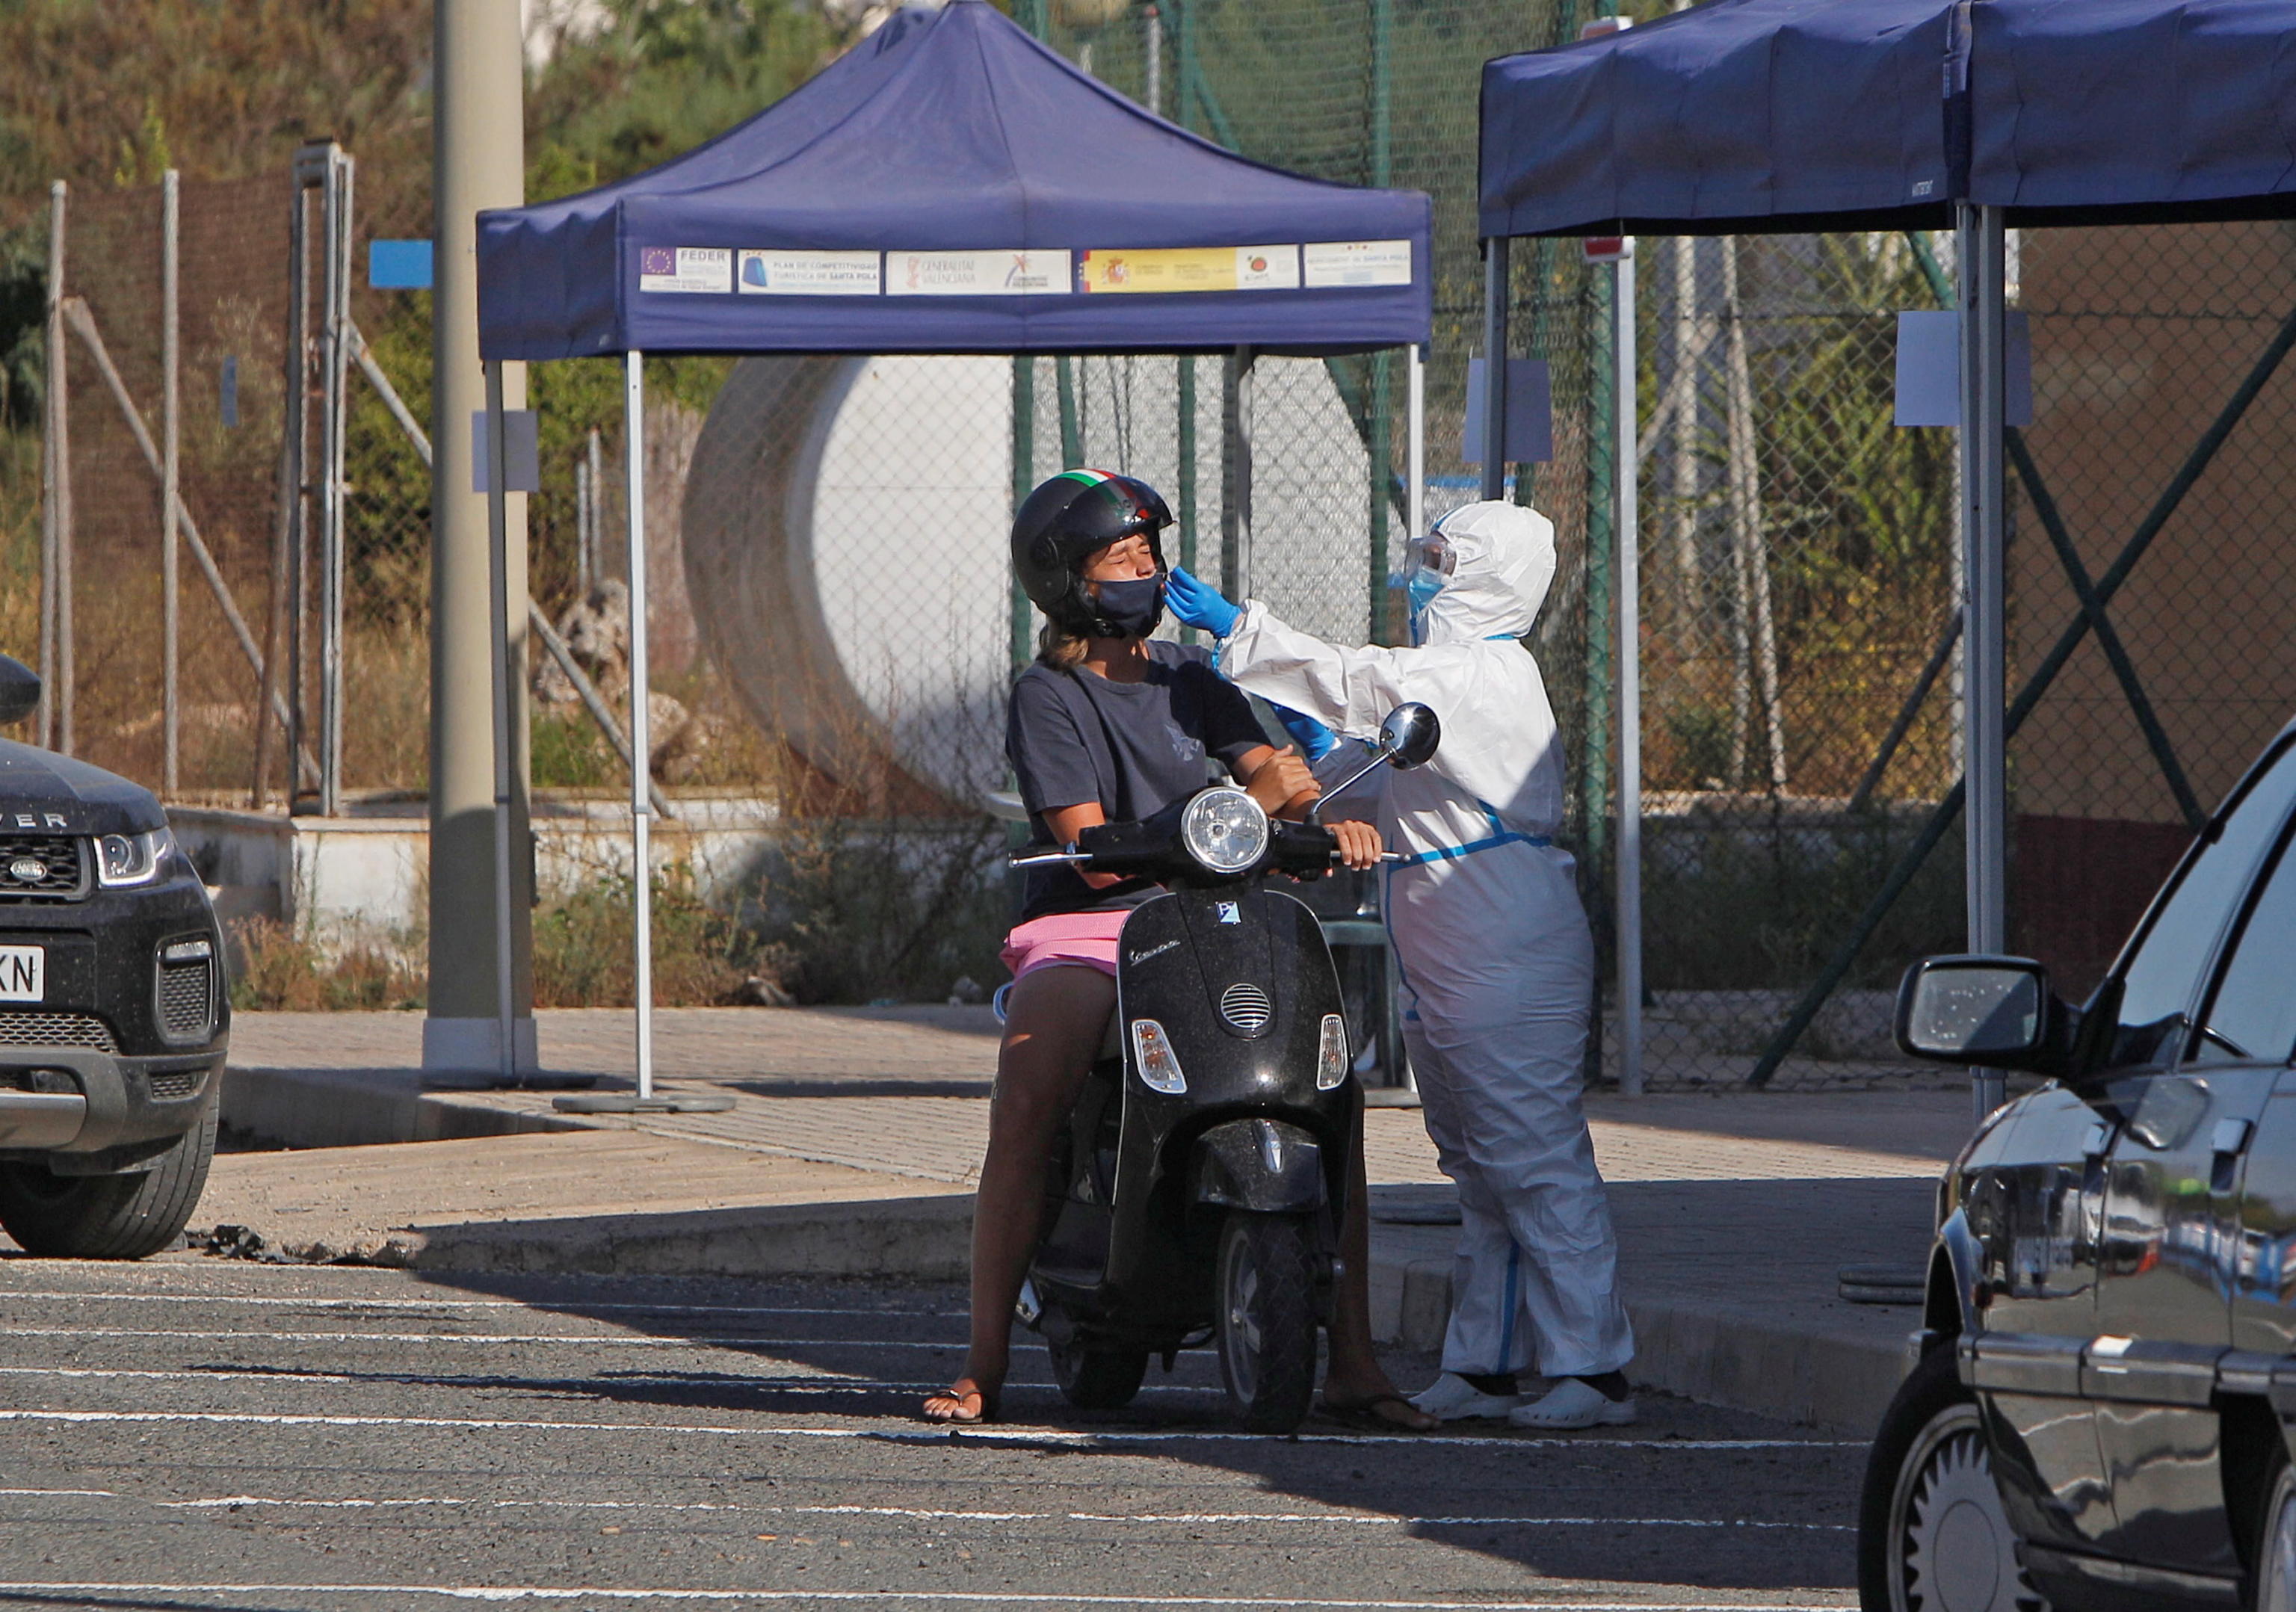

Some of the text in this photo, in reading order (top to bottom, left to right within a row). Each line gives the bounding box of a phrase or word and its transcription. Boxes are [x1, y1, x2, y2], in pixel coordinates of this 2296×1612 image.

[681, 250, 725, 262] FEDER
[857, 272, 877, 280] POLA
[0, 813, 68, 827] ER
